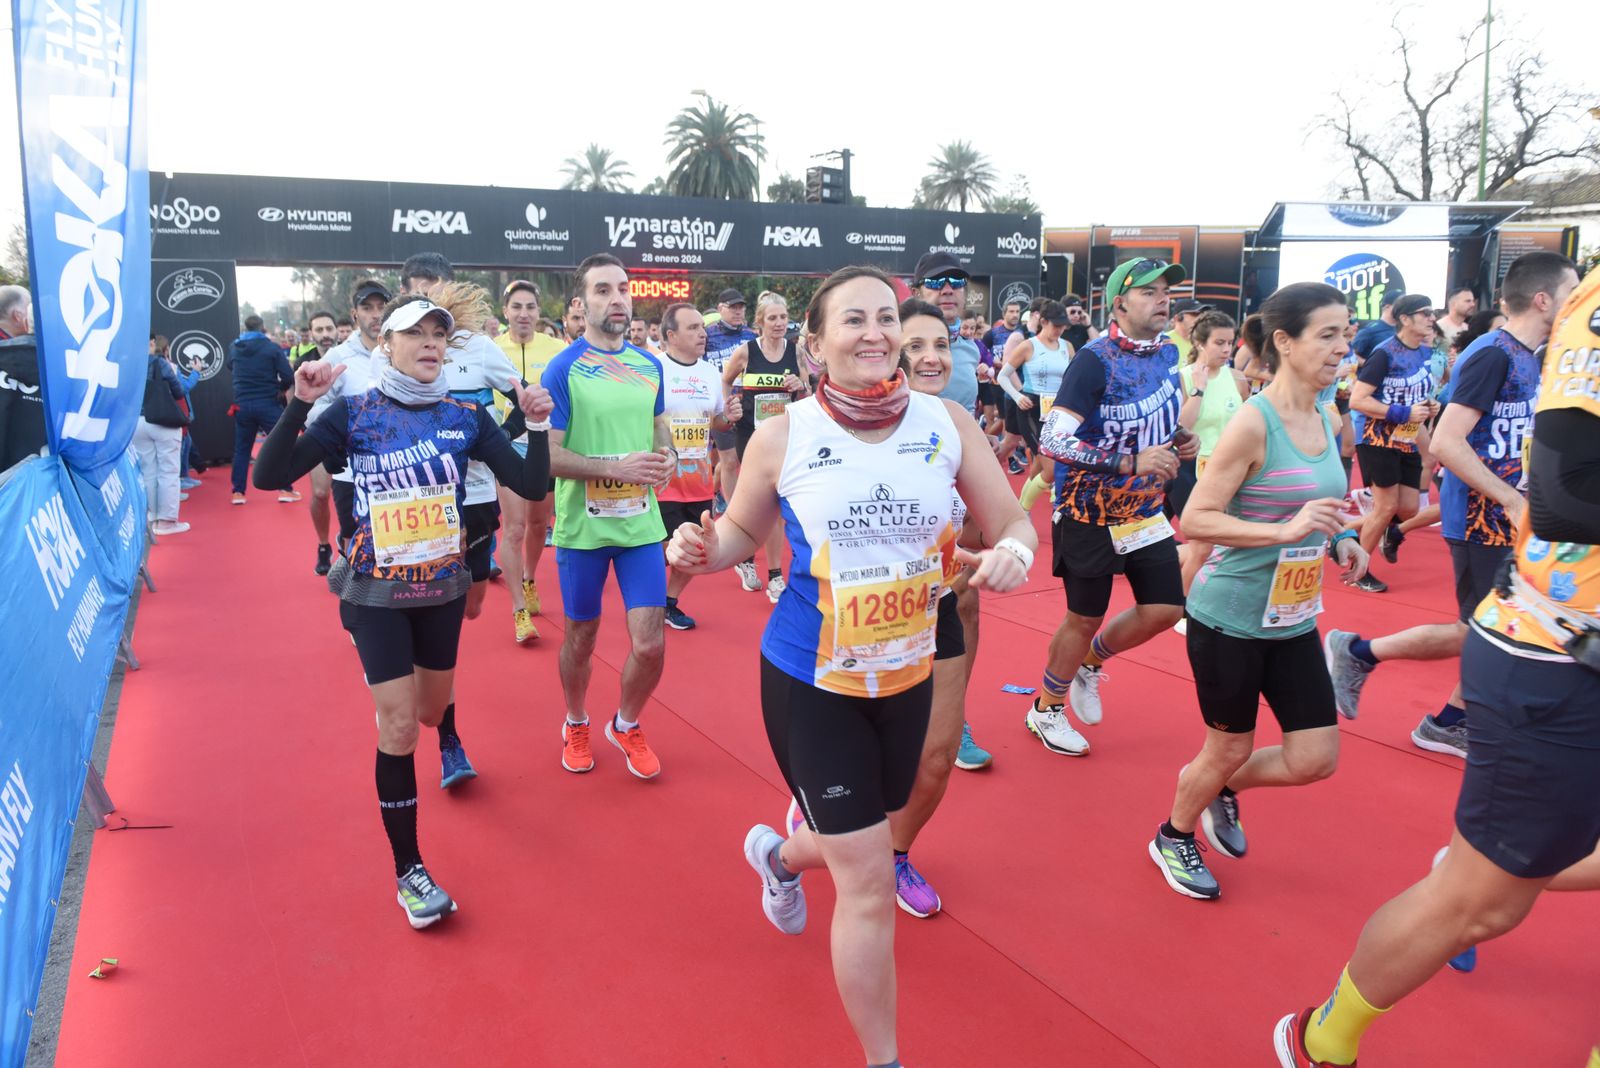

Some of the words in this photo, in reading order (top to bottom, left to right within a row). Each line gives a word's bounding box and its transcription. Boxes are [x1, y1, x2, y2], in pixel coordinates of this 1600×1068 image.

[287, 209, 352, 222] HYUNDAI
[392, 209, 471, 234] HOKA
[288, 223, 329, 232] Hyundauto
[330, 224, 352, 232] Motor
[630, 217, 716, 236] maratón
[653, 231, 716, 251] sevilla
[763, 226, 822, 248] HOKA
[864, 234, 906, 245] HYUNDAI
[510, 243, 541, 252] Healthcare
[642, 253, 653, 262] 28
[655, 255, 679, 263] enero
[681, 254, 702, 264] 2024
[49, 94, 129, 442] HOKA
[629, 280, 690, 298] 00:04:52
[1100, 404, 1138, 421] MEDIO
[1140, 378, 1175, 416] MARATÓN
[1491, 401, 1526, 418] MEDIO
[1097, 388, 1184, 454] SEVILL
[436, 430, 465, 440] HOKA
[674, 428, 705, 441] 11819
[353, 453, 377, 473] MEDIO
[379, 439, 439, 469] MARATÓN
[808, 458, 843, 470] VIATOR
[355, 452, 461, 516] SEVILLA
[420, 486, 444, 497] SEVILLA
[379, 503, 446, 533] 11512
[849, 503, 920, 516] MONTE
[828, 518, 870, 531] DON
[880, 515, 938, 527] LUCIO
[855, 527, 896, 536] VARIETALES
[846, 538, 878, 548] GRUPO
[881, 536, 921, 546] HUERTAS
[25, 491, 86, 611] HOKA
[840, 570, 859, 582] MEDIO
[860, 566, 890, 580] MARATÓN
[846, 582, 929, 628] 12864
[1, 761, 34, 838] FLY
